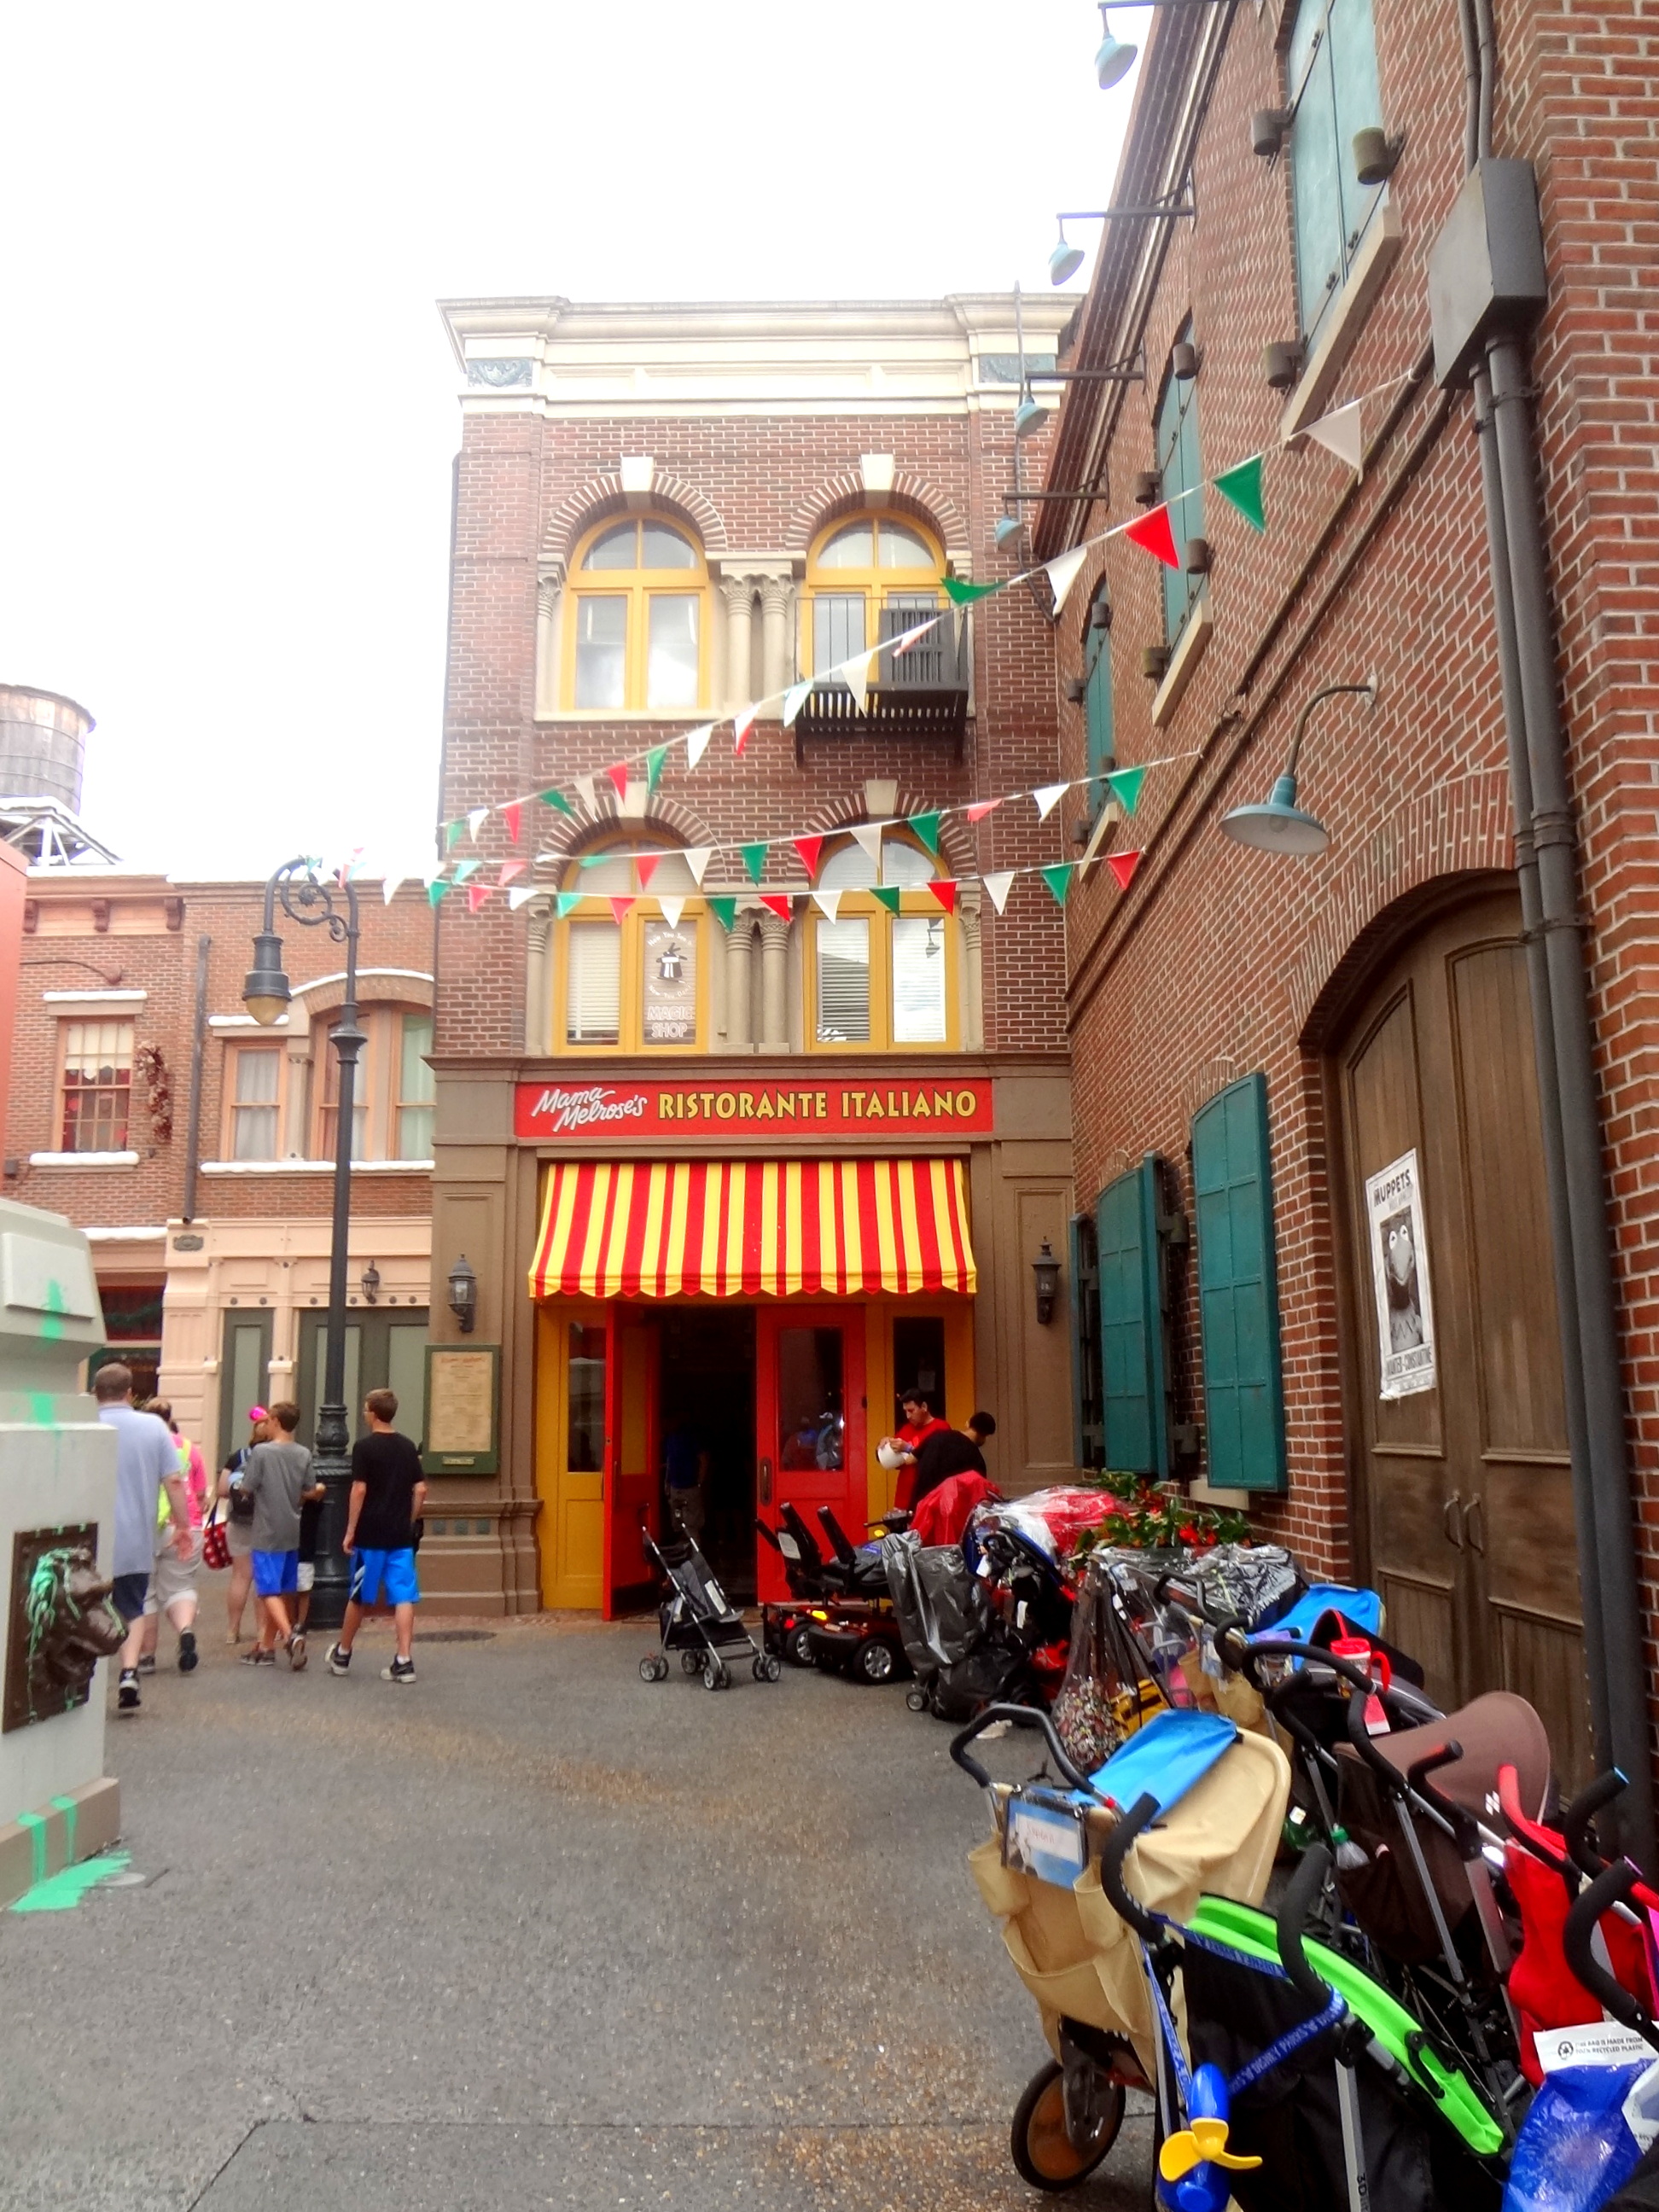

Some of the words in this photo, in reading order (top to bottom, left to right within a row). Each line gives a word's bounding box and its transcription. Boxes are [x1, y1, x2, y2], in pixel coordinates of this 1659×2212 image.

[647, 1005, 693, 1022] MAGIC
[650, 1022, 688, 1039] SHOP
[531, 1086, 616, 1117] Mama
[552, 1094, 649, 1133] Melrose's
[658, 1089, 828, 1120] RISTORANTE
[841, 1087, 977, 1119] ITALIANO
[1373, 1168, 1412, 1208] MUPPETS
